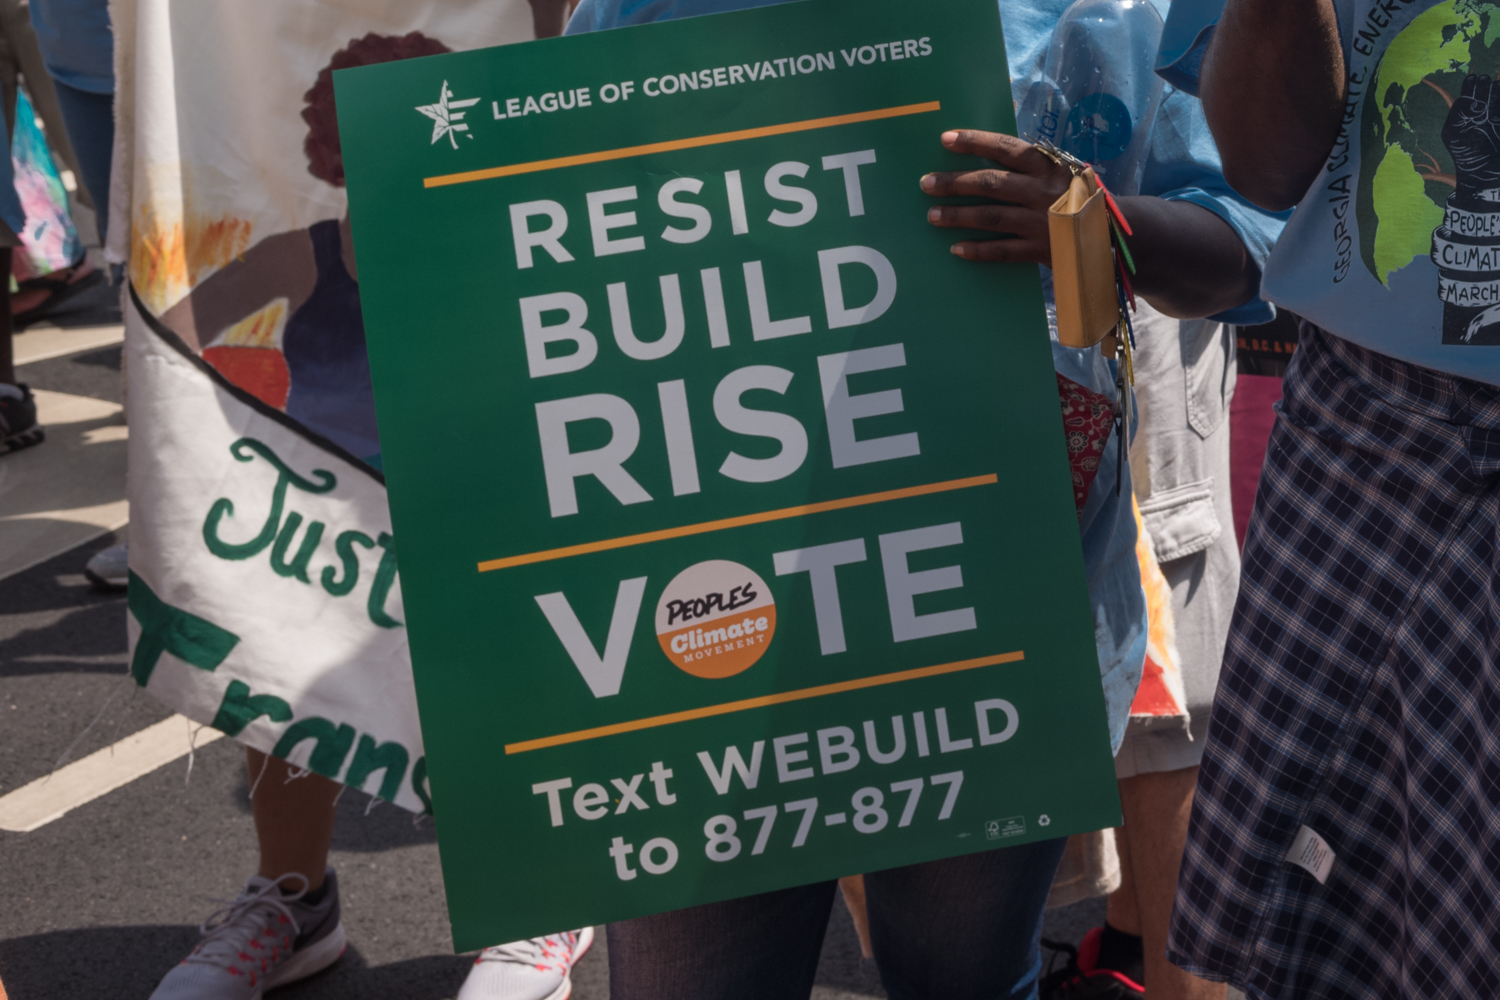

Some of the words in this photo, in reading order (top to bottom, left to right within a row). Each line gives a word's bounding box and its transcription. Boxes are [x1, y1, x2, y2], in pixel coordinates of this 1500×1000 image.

[492, 87, 592, 120] LEAGUE
[599, 81, 635, 104] OF
[643, 50, 836, 98] CONSERVATION
[840, 36, 933, 69] VOTERS
[508, 148, 877, 269] RESIST
[1328, 174, 1352, 284] GEORGIA
[518, 245, 897, 379] BUILD
[1446, 283, 1499, 304] MARCH
[534, 342, 921, 518] RISE
[203, 437, 405, 629] Just
[666, 582, 757, 625] PEOPLES
[670, 616, 768, 654] Climate
[683, 634, 764, 663] MOVEMENT
[532, 761, 677, 827] Text
[696, 698, 1020, 796] WEBUILD
[609, 836, 679, 882] to
[703, 770, 965, 863] 877-877
